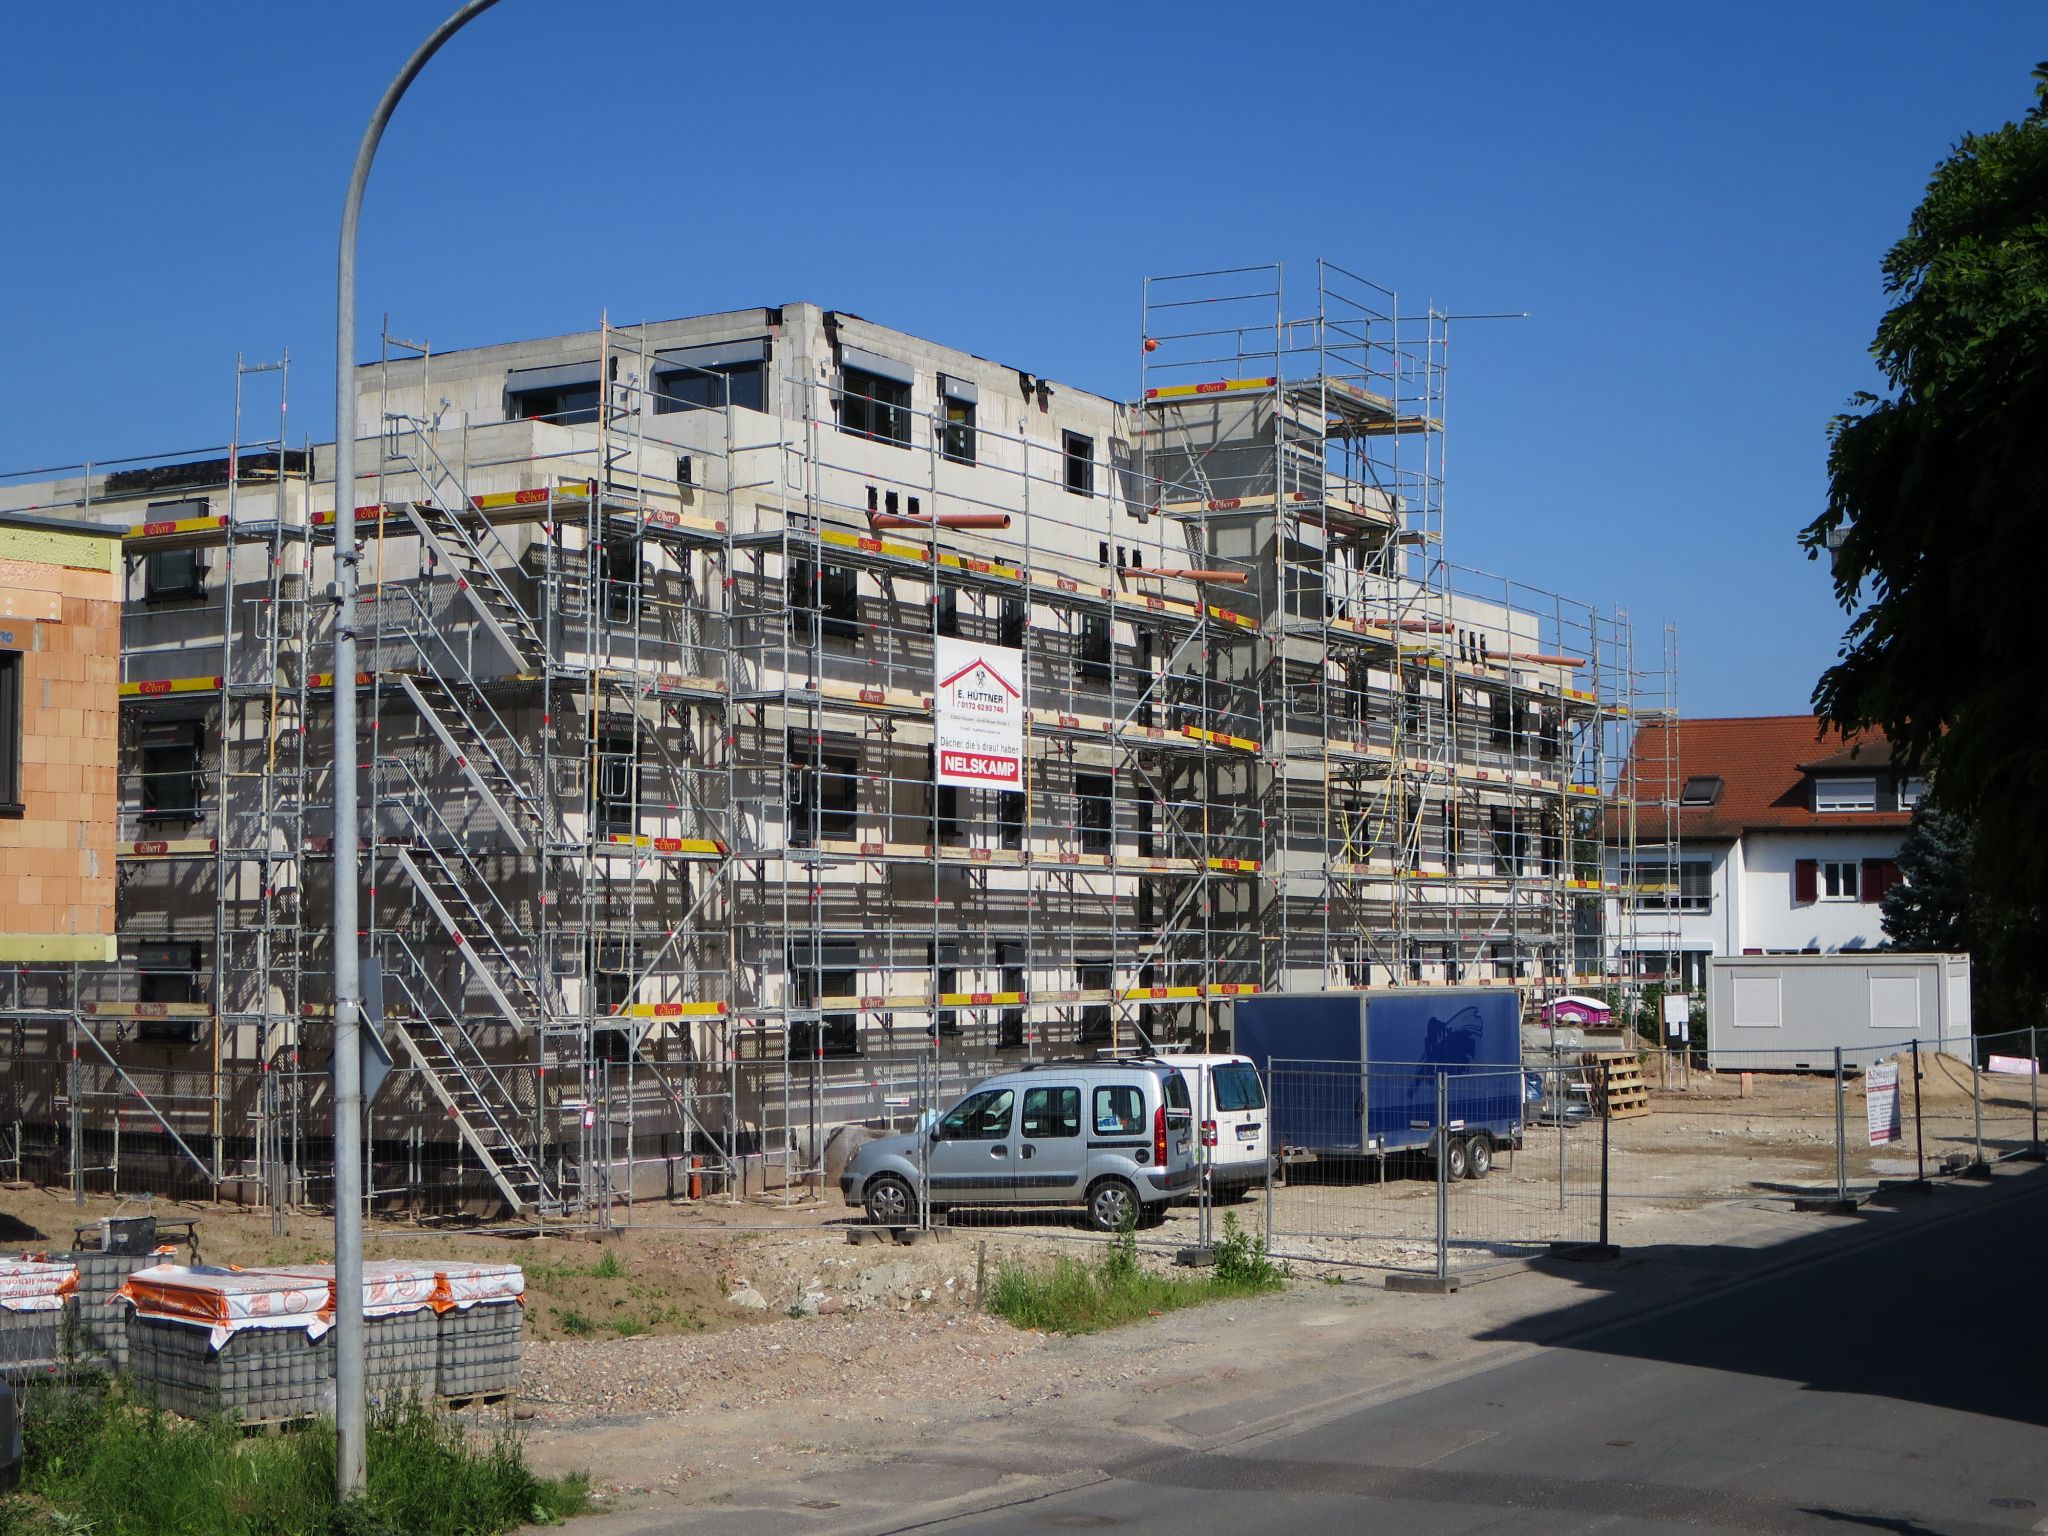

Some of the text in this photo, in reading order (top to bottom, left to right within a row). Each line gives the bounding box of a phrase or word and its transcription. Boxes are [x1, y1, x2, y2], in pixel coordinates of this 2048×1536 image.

[957, 689, 1003, 704] E. HÜTTNER
[961, 701, 976, 710] 0172
[982, 741, 999, 752] drauf
[1001, 743, 1019, 754] haben
[944, 755, 1016, 777] NELSKAMP
